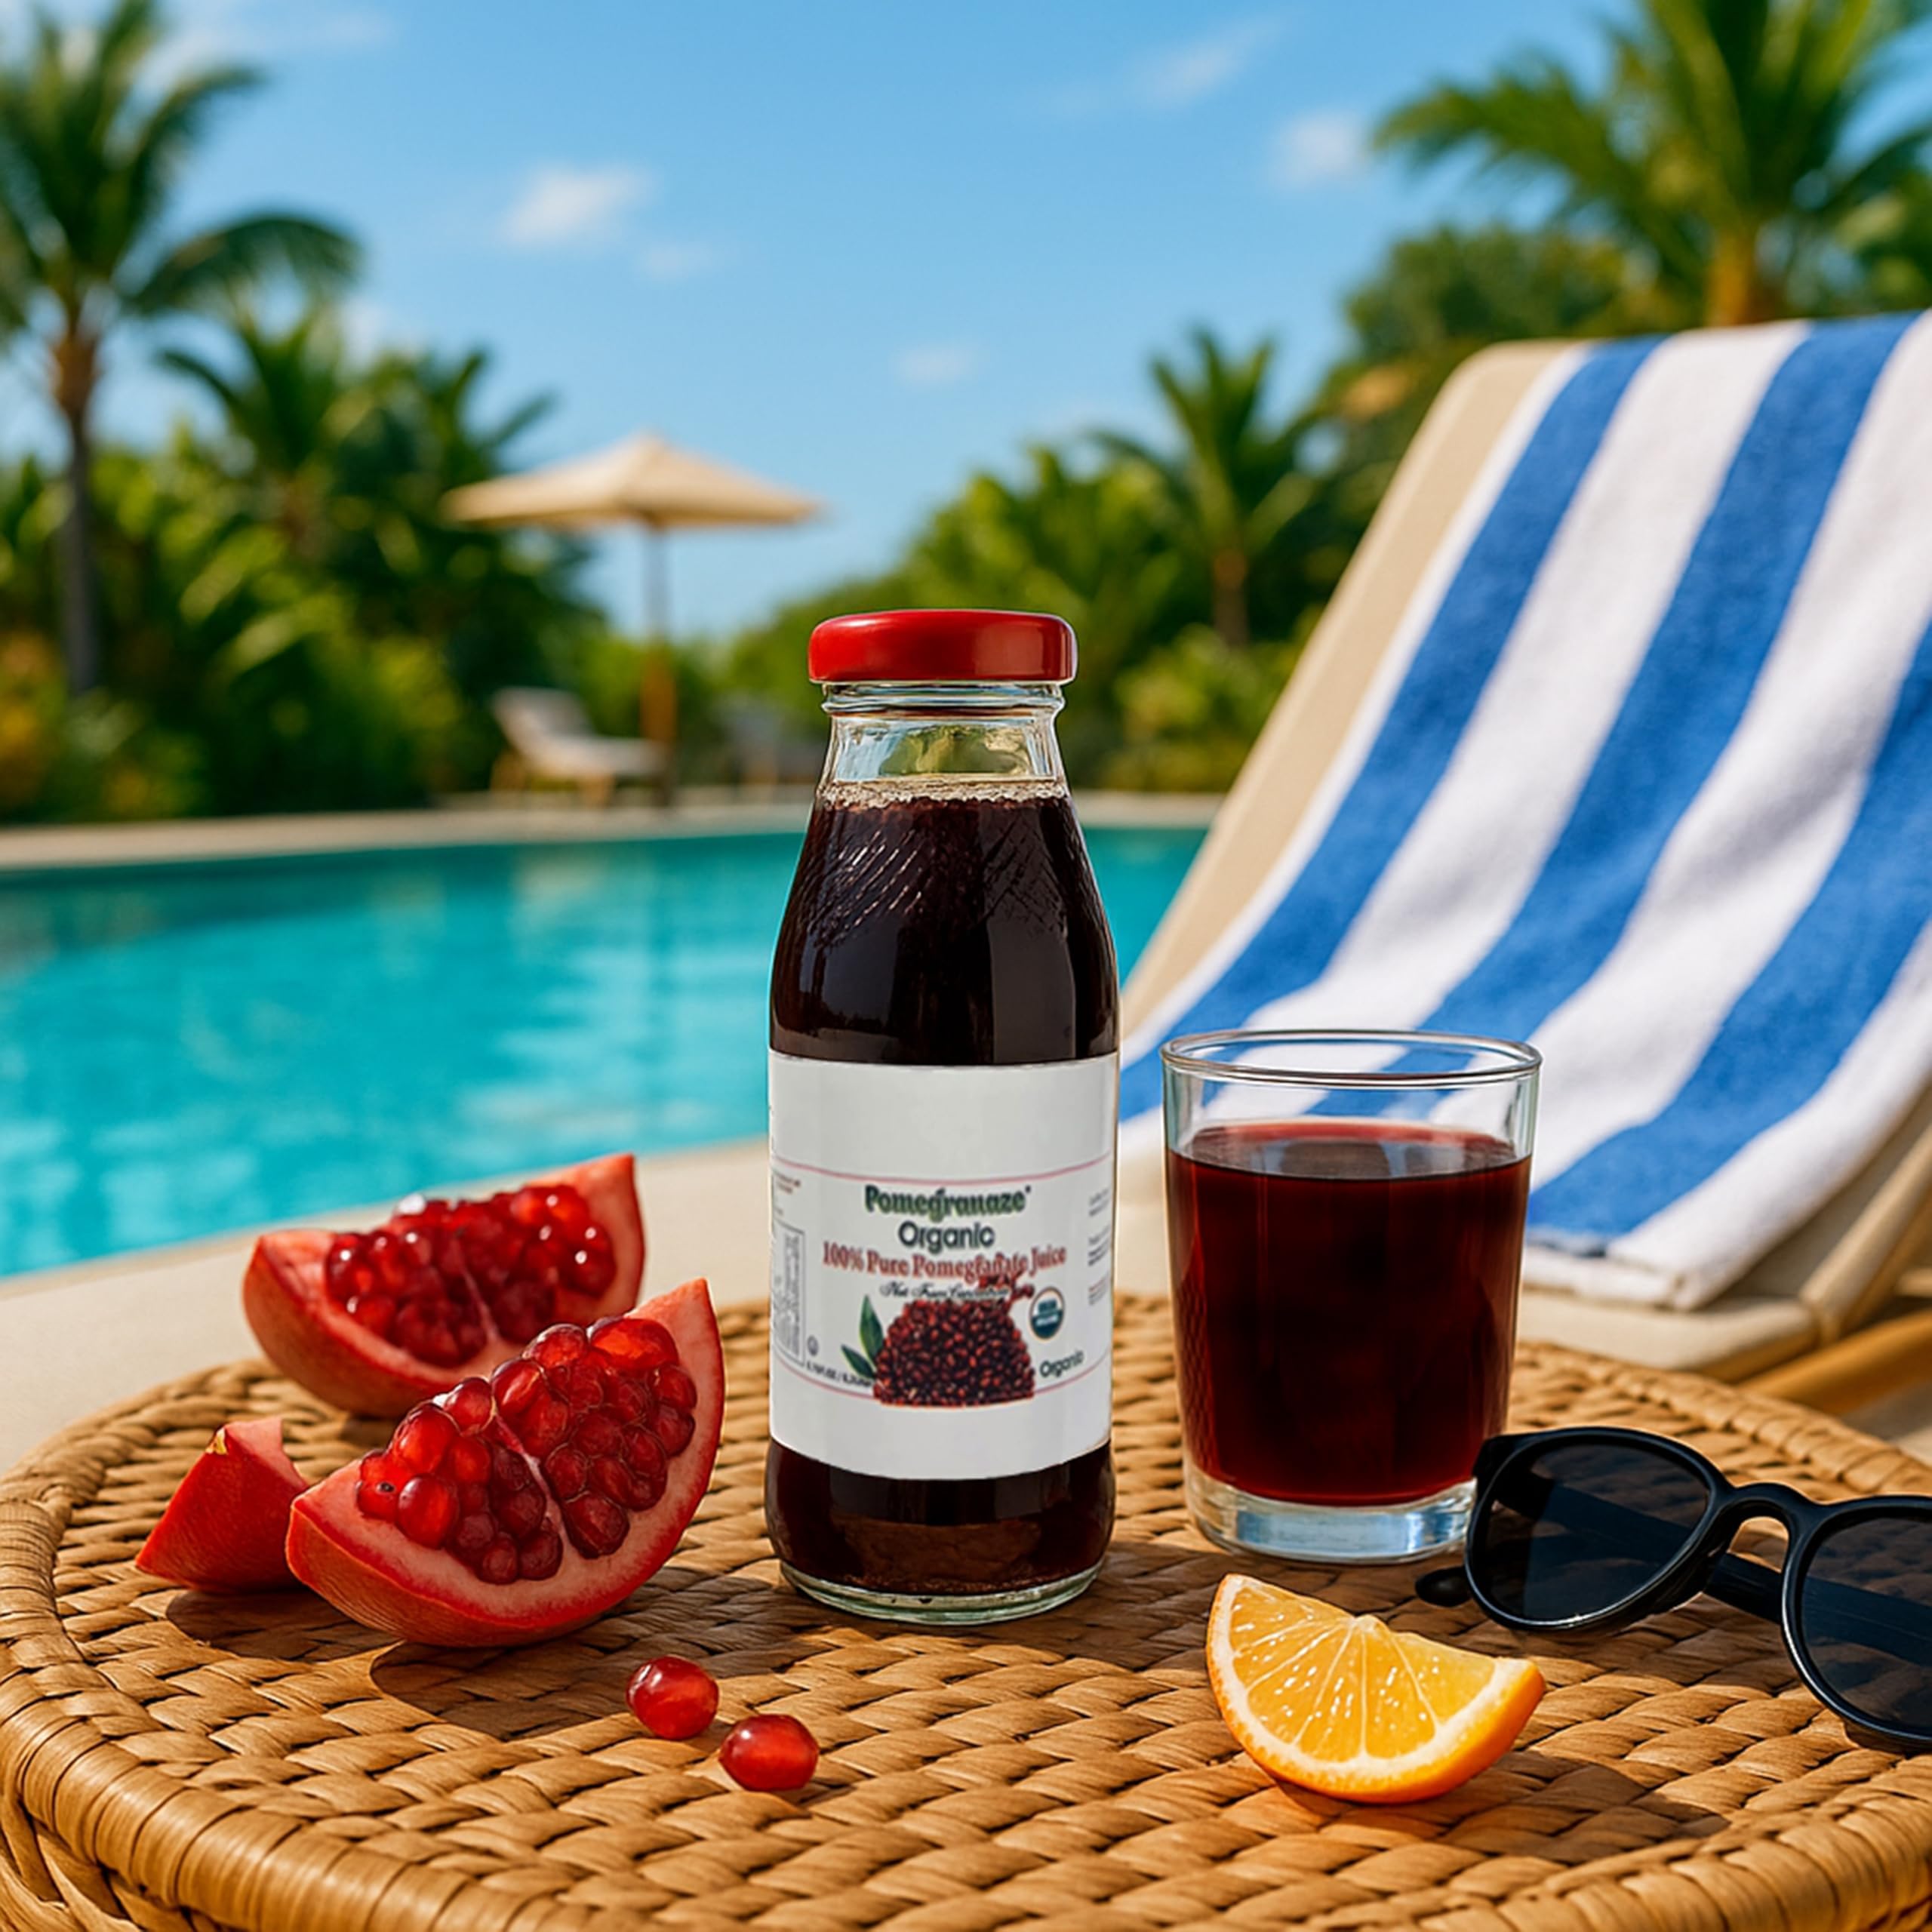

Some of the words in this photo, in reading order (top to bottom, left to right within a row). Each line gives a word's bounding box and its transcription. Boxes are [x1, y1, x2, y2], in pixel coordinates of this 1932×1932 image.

[897, 1220, 995, 1254] Organic
[823, 1241, 864, 1272] 100%
[866, 1250, 909, 1276] Pure
[1029, 1245, 1066, 1277] Juice
[1039, 1349, 1084, 1378] Organic
